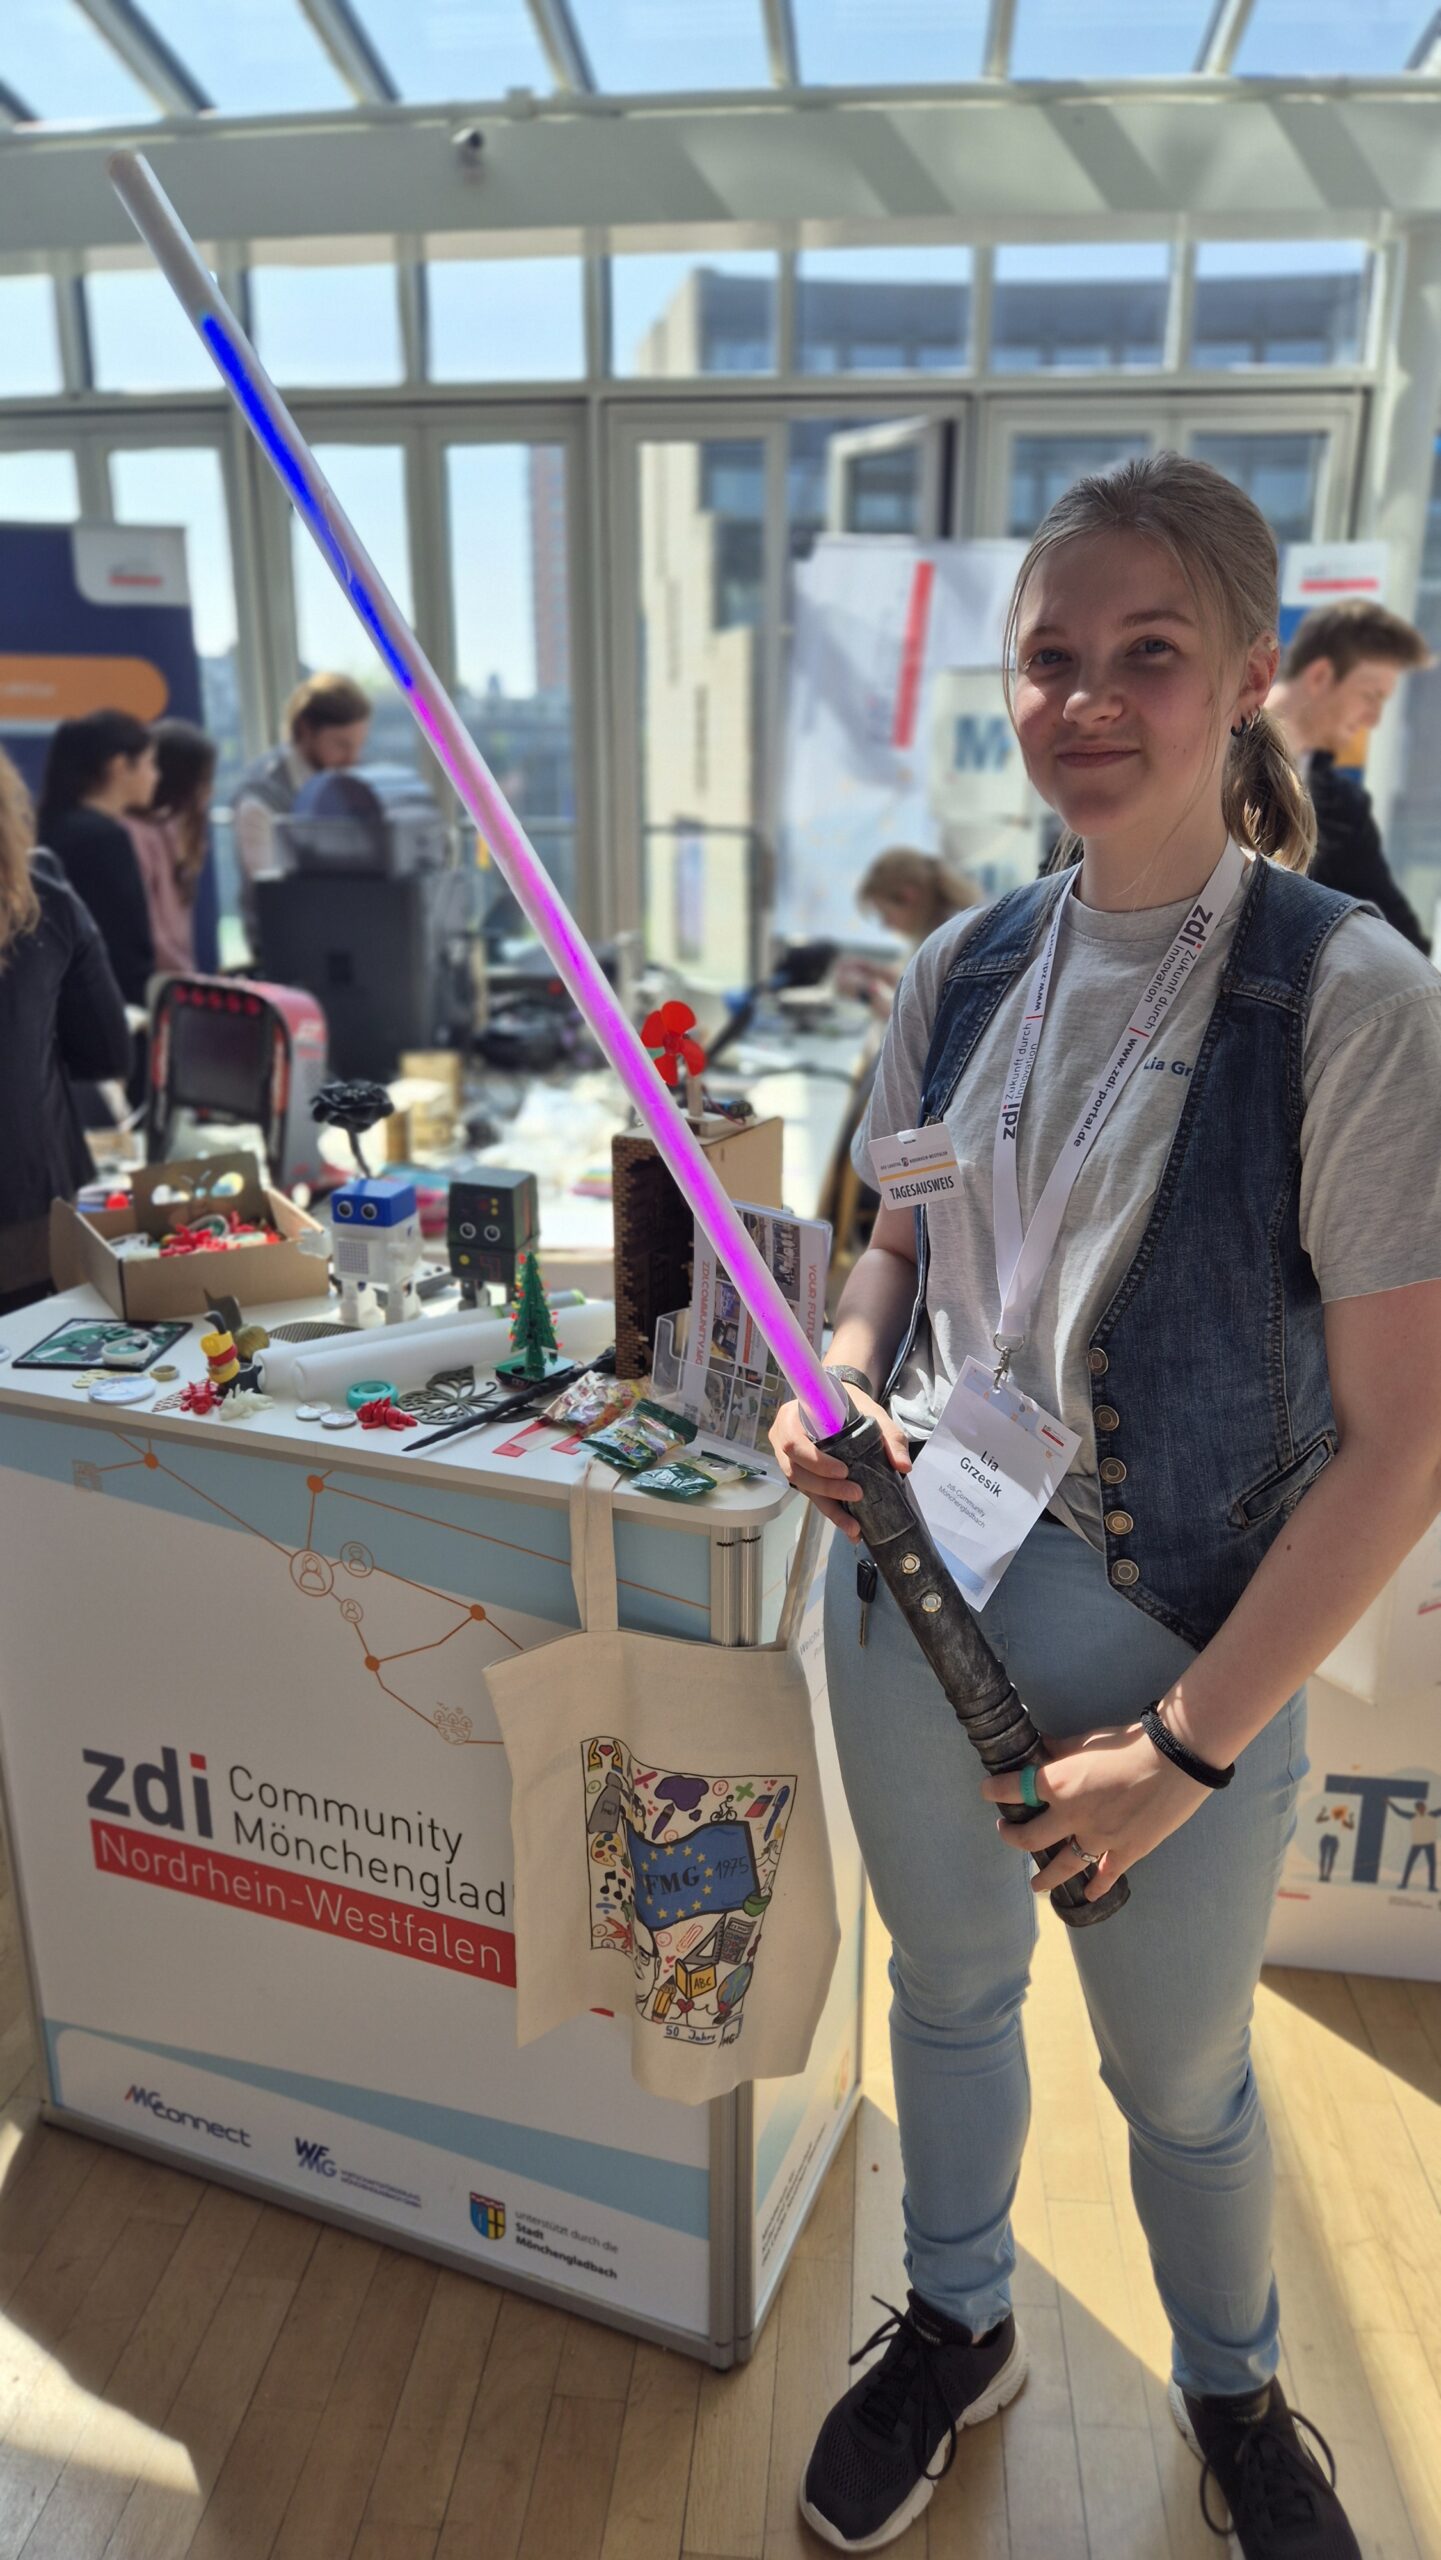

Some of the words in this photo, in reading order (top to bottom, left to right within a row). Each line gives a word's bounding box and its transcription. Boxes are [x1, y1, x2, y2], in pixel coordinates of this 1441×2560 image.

[1179, 905, 1213, 949] zdi
[1143, 945, 1184, 1003] Innovation
[1167, 949, 1197, 995] Zukunft
[1145, 996, 1169, 1030] durch
[1005, 1056, 1024, 1100] Zukunft
[1018, 1022, 1032, 1055] durch
[1017, 1042, 1037, 1099] Innovation
[1144, 1056, 1165, 1071] Lia
[1074, 1038, 1138, 1147] www.zdi-portal.de
[1002, 1102, 1020, 1141] zdi
[889, 1175, 955, 1201] TAGESAUSWEIS
[807, 1264, 818, 1299] YOUR
[805, 1301, 817, 1349] FUTUR
[960, 1456, 1003, 1498] Grzesik
[980, 1450, 1000, 1473] Lia
[82, 1746, 214, 1840] zdi
[229, 1765, 463, 1866] Community
[233, 1811, 514, 1918] Mönchenglad
[641, 1866, 700, 1897] FMG
[715, 1856, 750, 1880] 1975
[99, 1829, 502, 1974] Nordrhein-Westfalen
[694, 1977, 712, 1990] ABC
[666, 2025, 680, 2036] 50
[515, 2222, 544, 2240] Stadt
[515, 2211, 568, 2236] unterstützt
[570, 2228, 600, 2247] durch
[602, 2240, 618, 2254] die
[515, 2235, 617, 2279] Mönchengladbach
